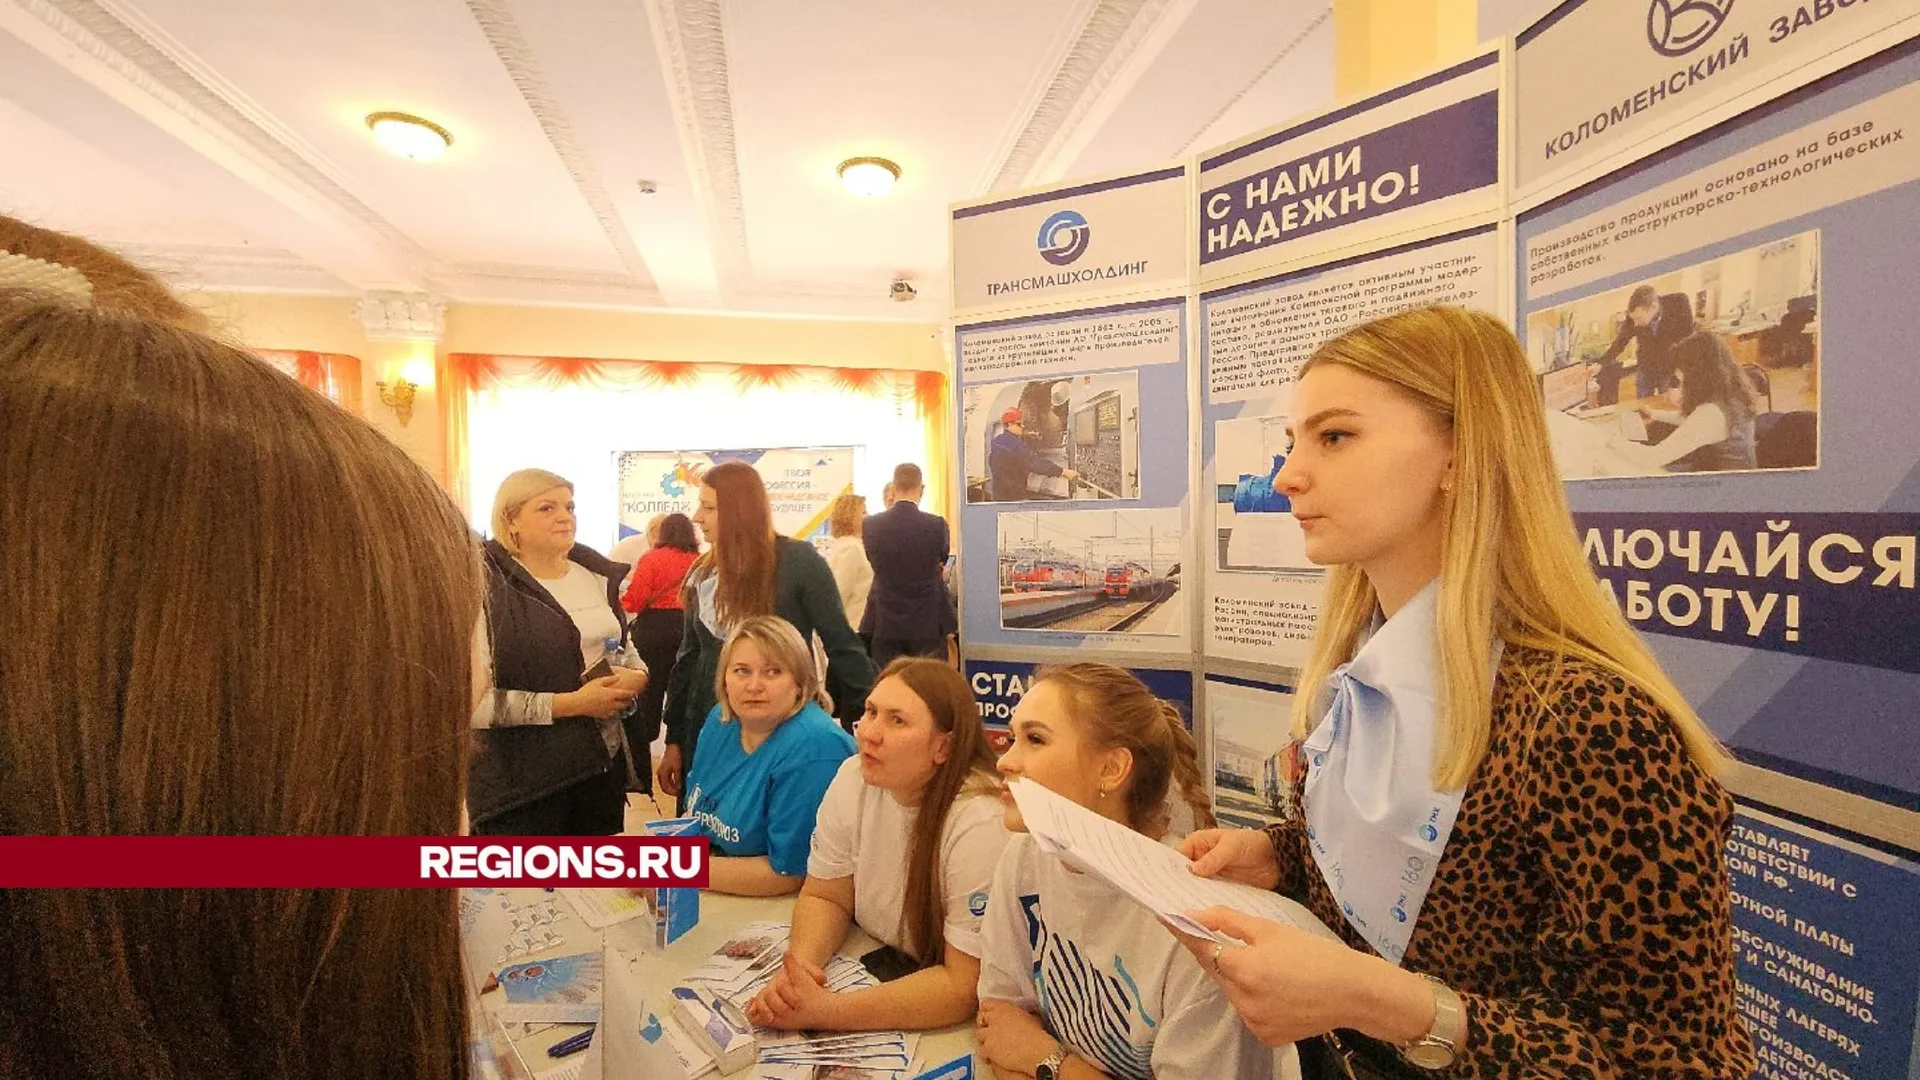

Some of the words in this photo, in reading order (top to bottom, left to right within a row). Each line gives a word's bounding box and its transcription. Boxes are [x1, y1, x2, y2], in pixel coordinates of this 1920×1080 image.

[1545, 32, 1749, 159] КОЛОМЕНСКИЙ
[1768, 0, 1868, 43] ЗАВ
[1206, 193, 1231, 220] С
[1246, 145, 1361, 209] НАМИ
[1207, 164, 1419, 254] НАДЕЖНО!
[1530, 221, 1615, 258] Производство
[1620, 188, 1698, 225] продукции
[1705, 153, 1789, 192] основано
[1796, 141, 1818, 159] на
[1826, 120, 1874, 146] базе
[1530, 238, 1609, 272] собственных
[1614, 128, 1904, 242] конструкторско-технологических
[987, 261, 1148, 295] ТРАНСМАШХОЛДИНГ
[1364, 277, 1432, 296] программы
[765, 481, 811, 490] ОФЕССИЯ
[1583, 520, 1916, 589] ЛЮЧАЙСЯ
[1252, 610, 1317, 622] специализир
[1725, 855, 1757, 878] ОМ
[1763, 868, 1793, 893] РФ.
[1726, 839, 1835, 891] ОТВЕТСТВИИ
[1842, 883, 1857, 897] С
[1732, 825, 1810, 862] ТАВЛЯЕТ
[1728, 891, 1787, 927] ОТНОЙ
[1793, 918, 1854, 956] ПЛАТЫ
[1731, 925, 1874, 1005] ОБСЛУЖИВАНИЕ
[1746, 949, 1758, 966] И
[1764, 960, 1878, 1024] САНАТОРНО-
[1735, 997, 1777, 1029] СШЕЕ
[1735, 978, 1780, 1012] ЬНЫХ
[1786, 1007, 1861, 1057] ЛАГЕРЯХ
